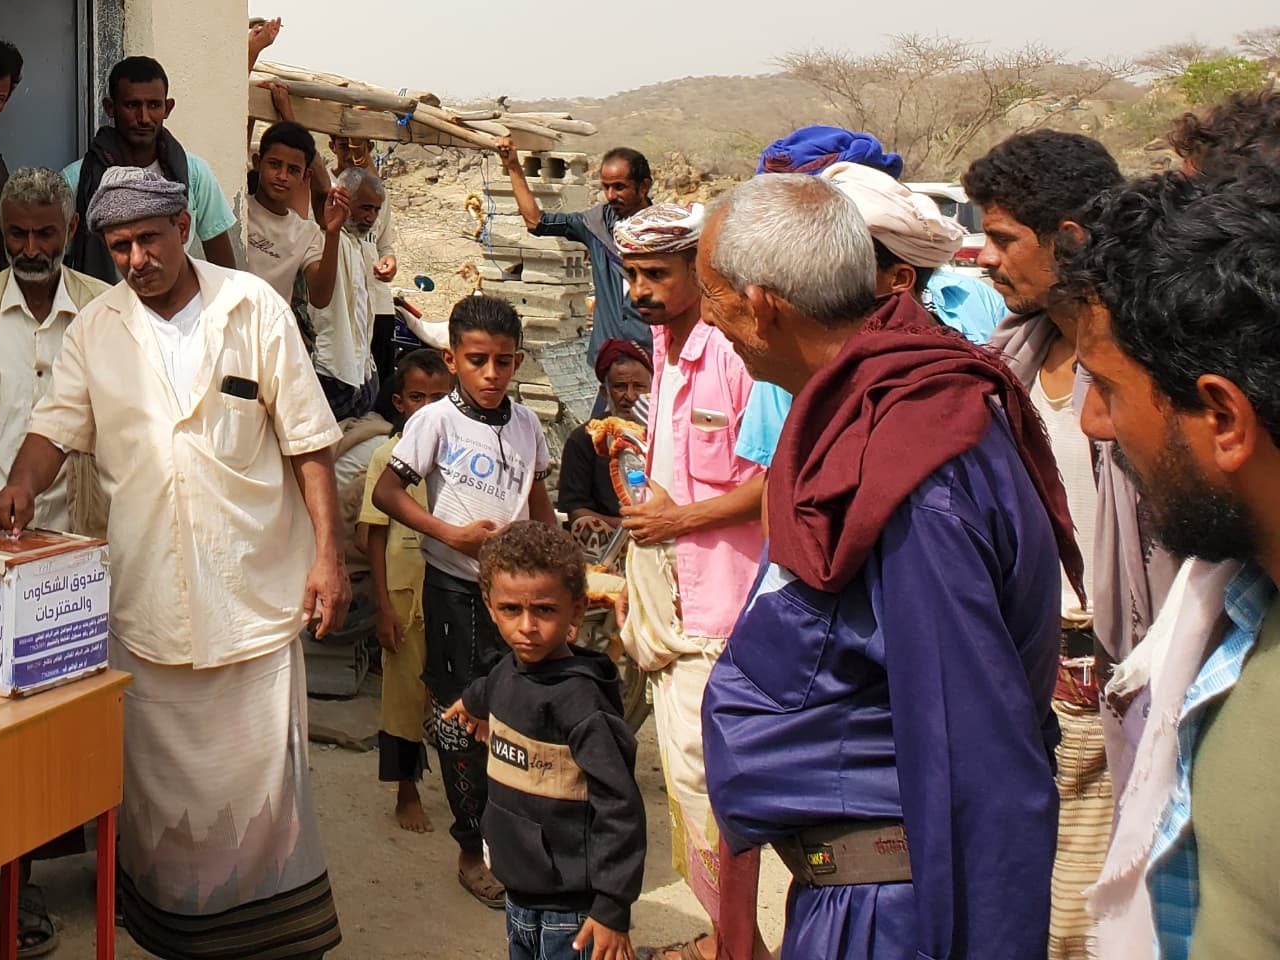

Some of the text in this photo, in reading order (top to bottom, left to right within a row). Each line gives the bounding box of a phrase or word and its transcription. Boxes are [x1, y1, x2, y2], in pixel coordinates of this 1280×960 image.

[448, 468, 506, 501] POSSIBLE
[23, 568, 105, 601] صندوق الشكاوى
[35, 596, 92, 622] والمقترحات
